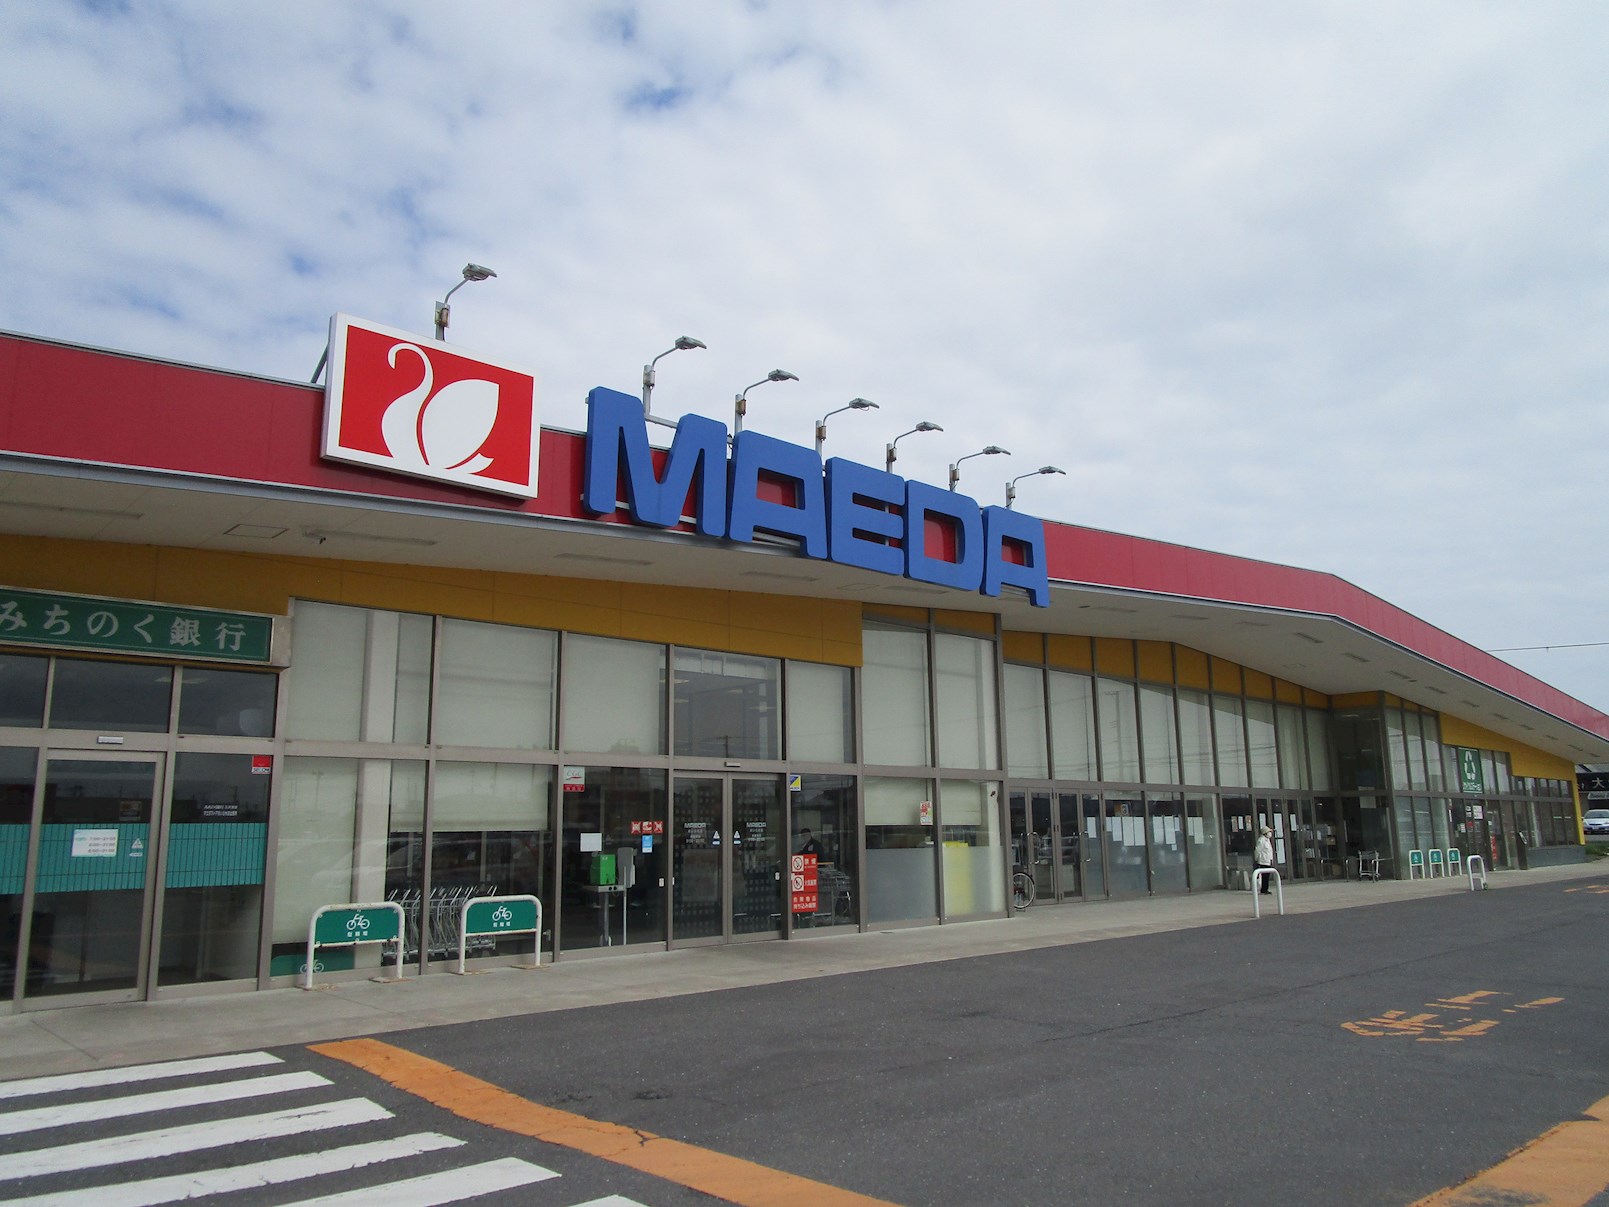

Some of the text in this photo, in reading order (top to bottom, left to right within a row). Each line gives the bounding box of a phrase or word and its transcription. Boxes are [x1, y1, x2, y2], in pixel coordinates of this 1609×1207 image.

[583, 386, 1050, 608] MAEDA
[0, 601, 247, 651] みちのく銀行
